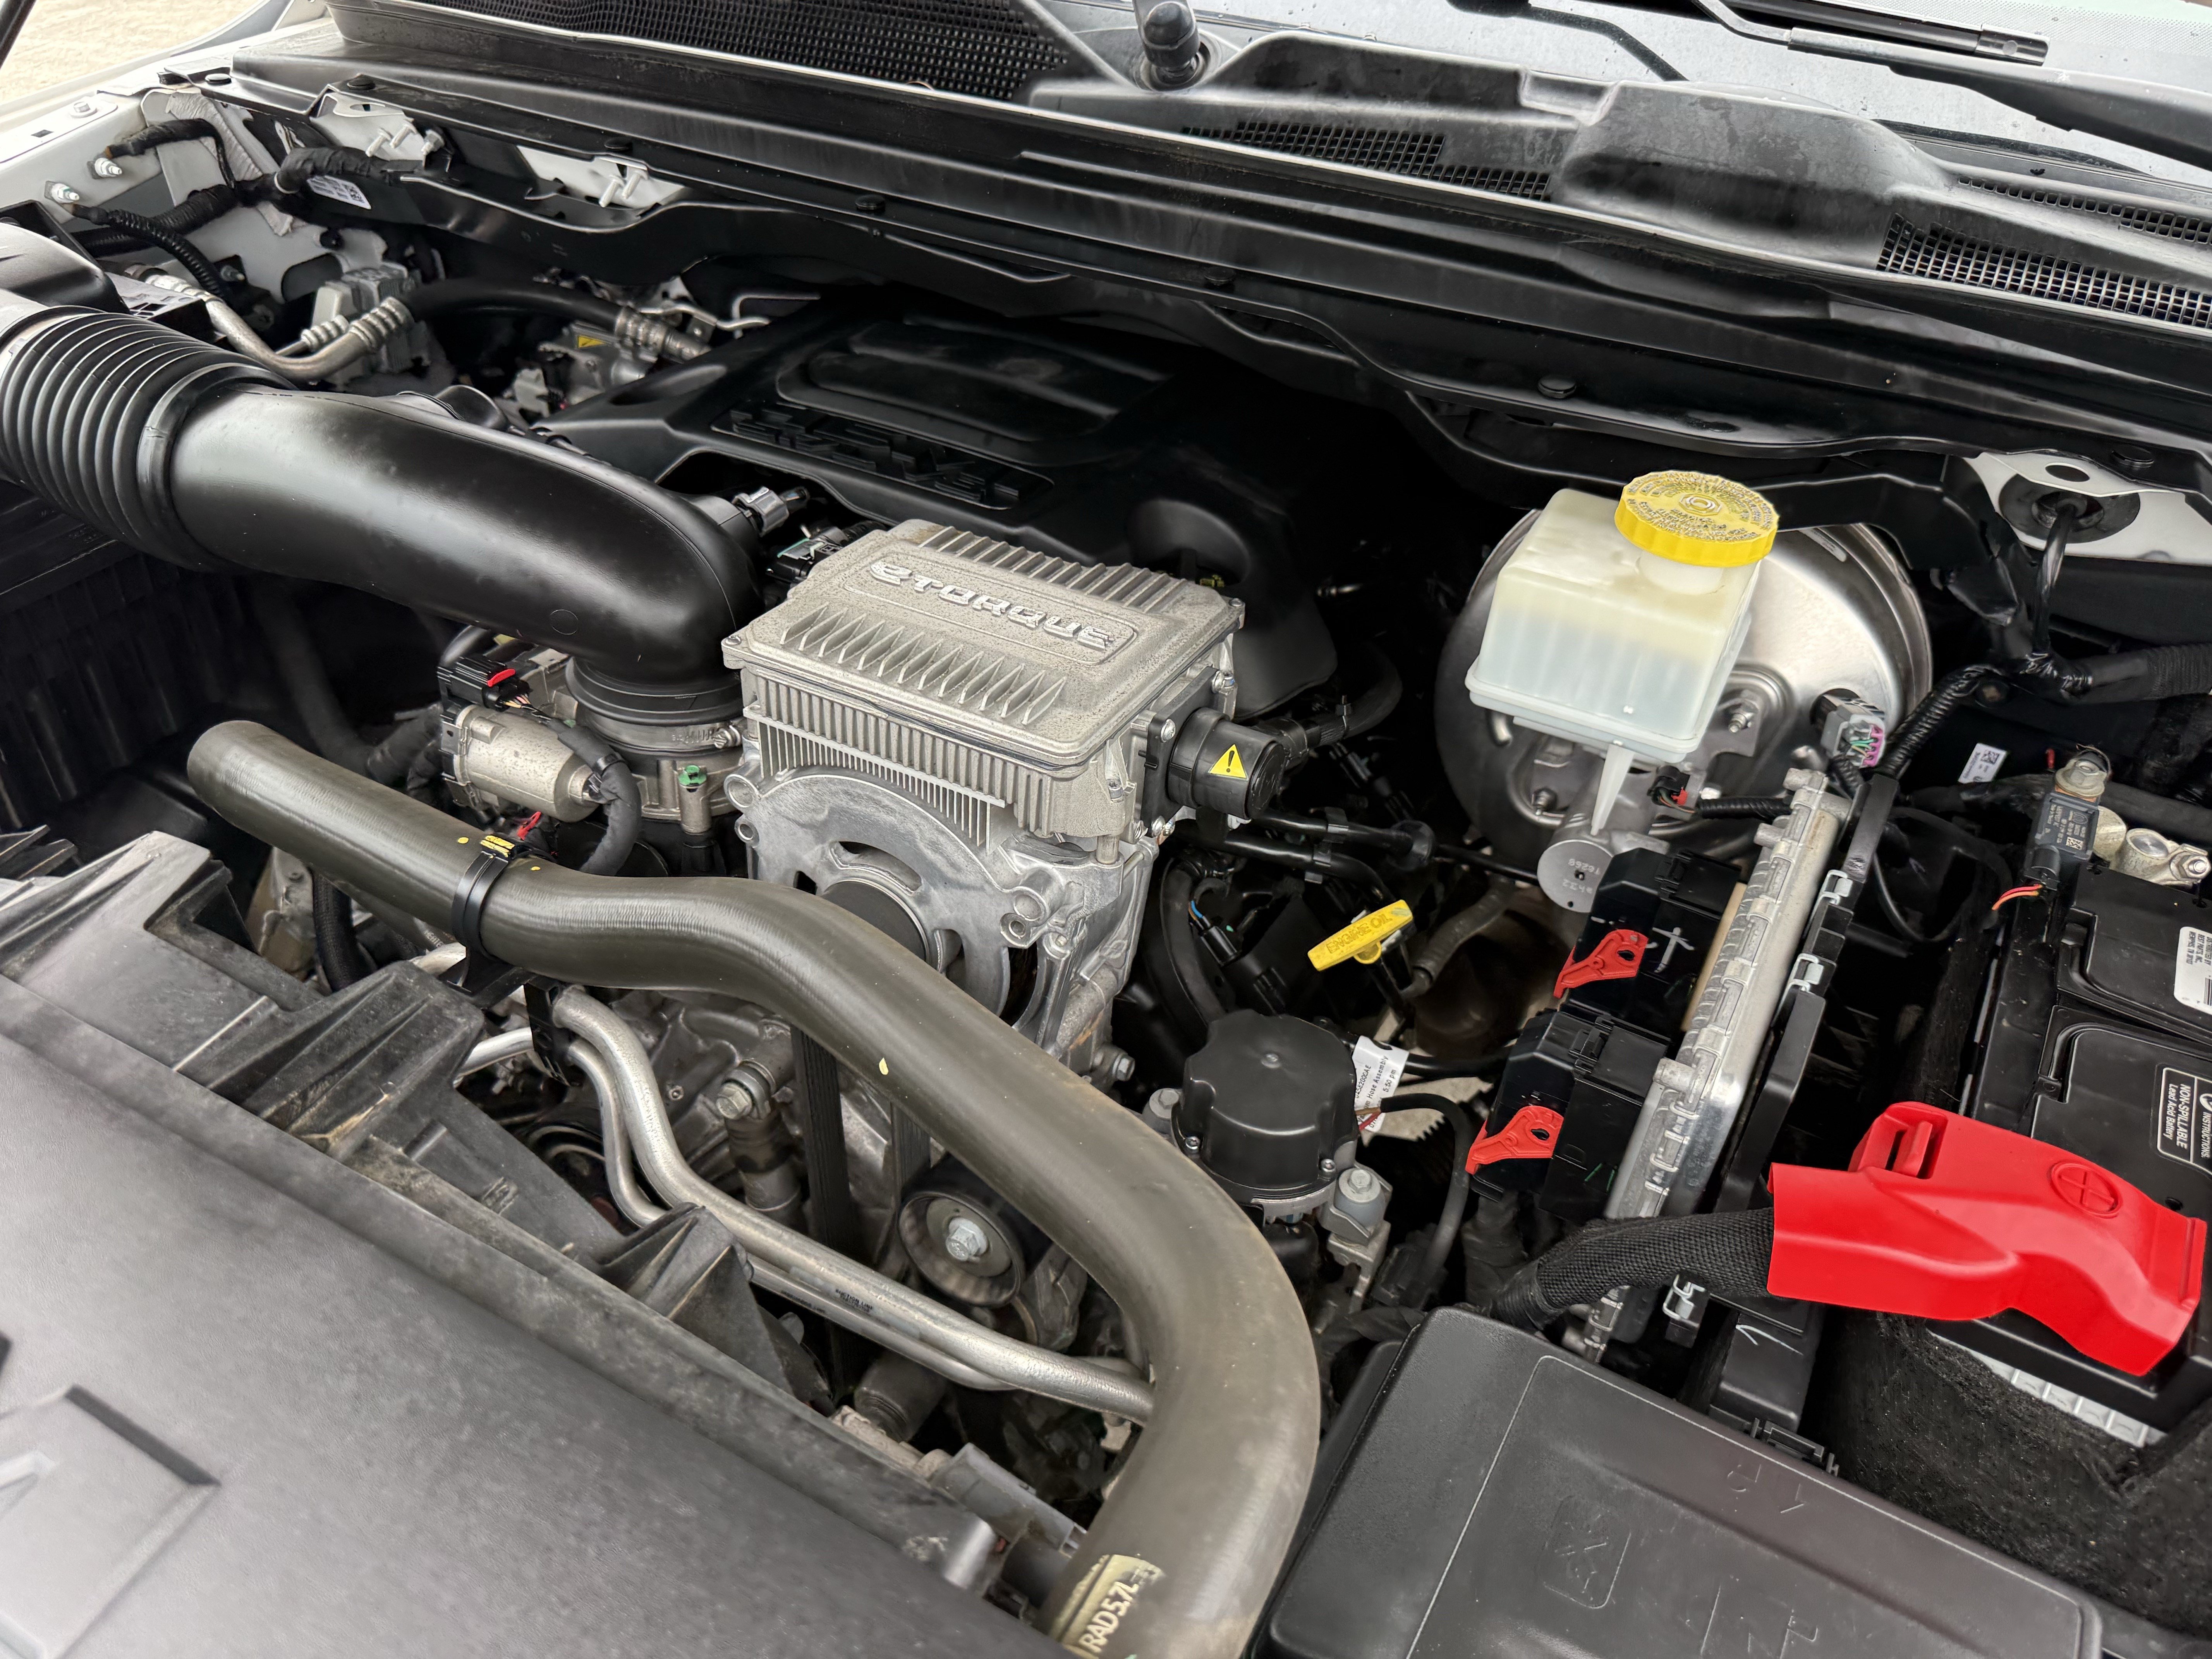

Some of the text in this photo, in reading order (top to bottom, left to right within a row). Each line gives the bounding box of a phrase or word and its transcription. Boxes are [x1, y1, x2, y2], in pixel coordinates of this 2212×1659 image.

[424, 930, 444, 947] HEATE
[1326, 914, 1393, 954] ENGINE OIL
[1367, 1084, 1376, 1099] Hose
[1373, 1056, 1388, 1084] Assembly
[1390, 1069, 1396, 1079] pm
[2163, 1084, 2178, 1140] Lead Acid Battery
[2176, 1084, 2191, 1150] NON-SPILLABLE
